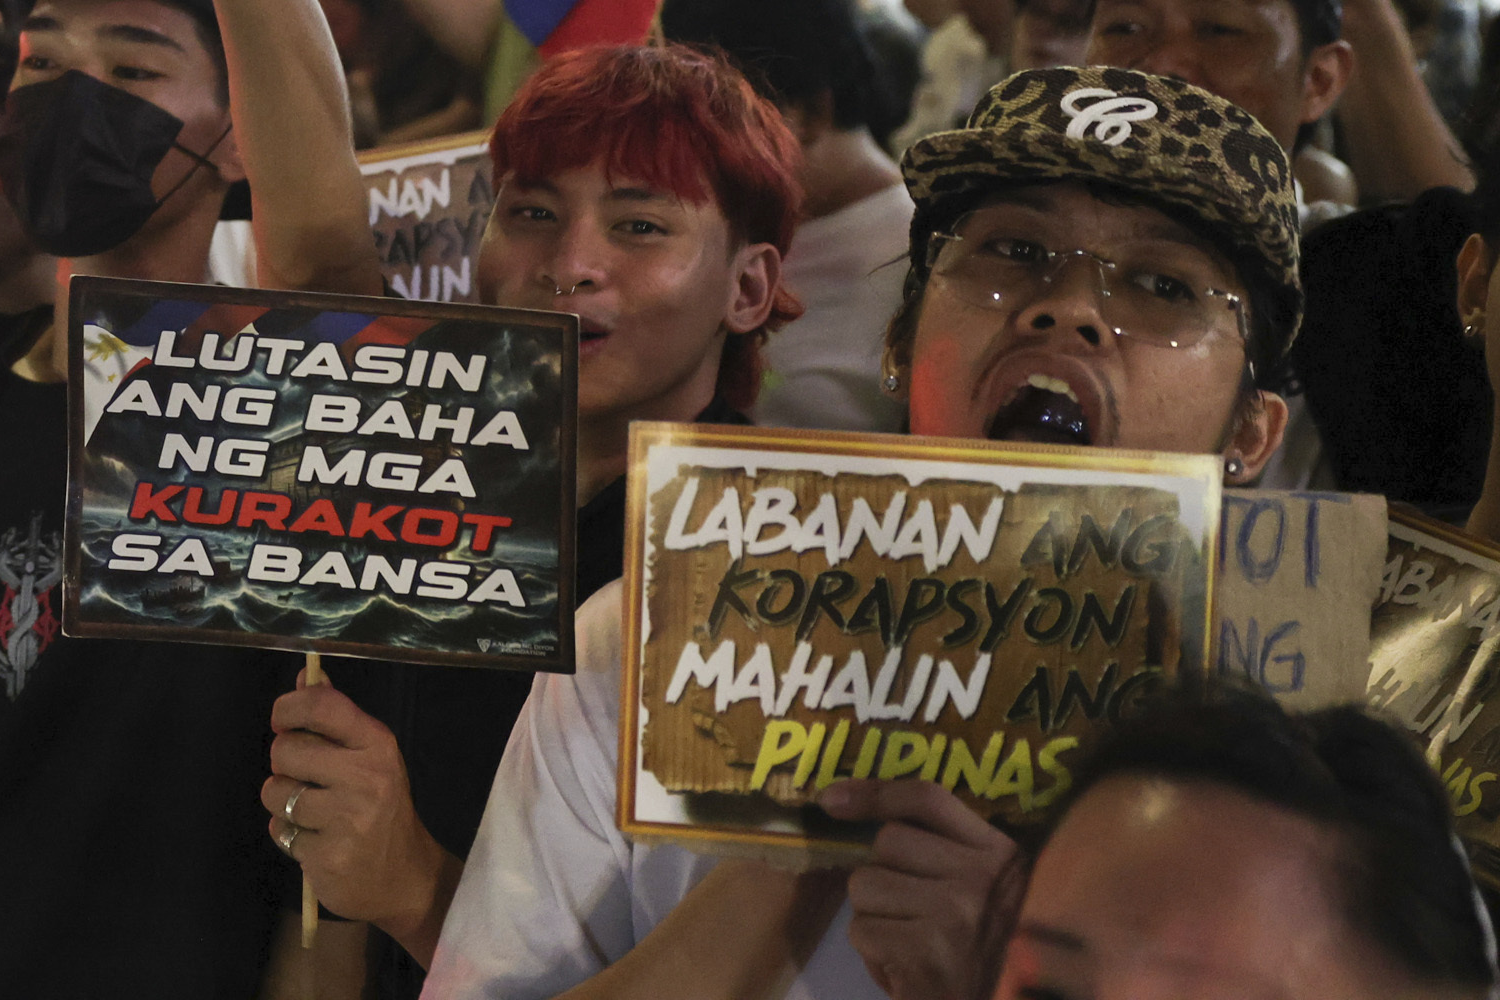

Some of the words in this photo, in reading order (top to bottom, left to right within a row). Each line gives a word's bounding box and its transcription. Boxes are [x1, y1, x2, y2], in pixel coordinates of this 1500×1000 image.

[151, 330, 488, 392] LUTASIN
[106, 379, 278, 428] ANG
[303, 393, 530, 450] BAHA
[158, 432, 271, 478] NG
[297, 446, 477, 498] MGA
[128, 481, 513, 552] KURAKOT
[665, 477, 1005, 573] LABANAN
[1020, 506, 1176, 579] ANG
[108, 533, 215, 577] SA
[247, 543, 527, 608] BANSA
[706, 557, 1135, 651] KORAPSYON
[666, 639, 992, 723] MAHALIN
[749, 717, 1080, 813] PILIPINAS
